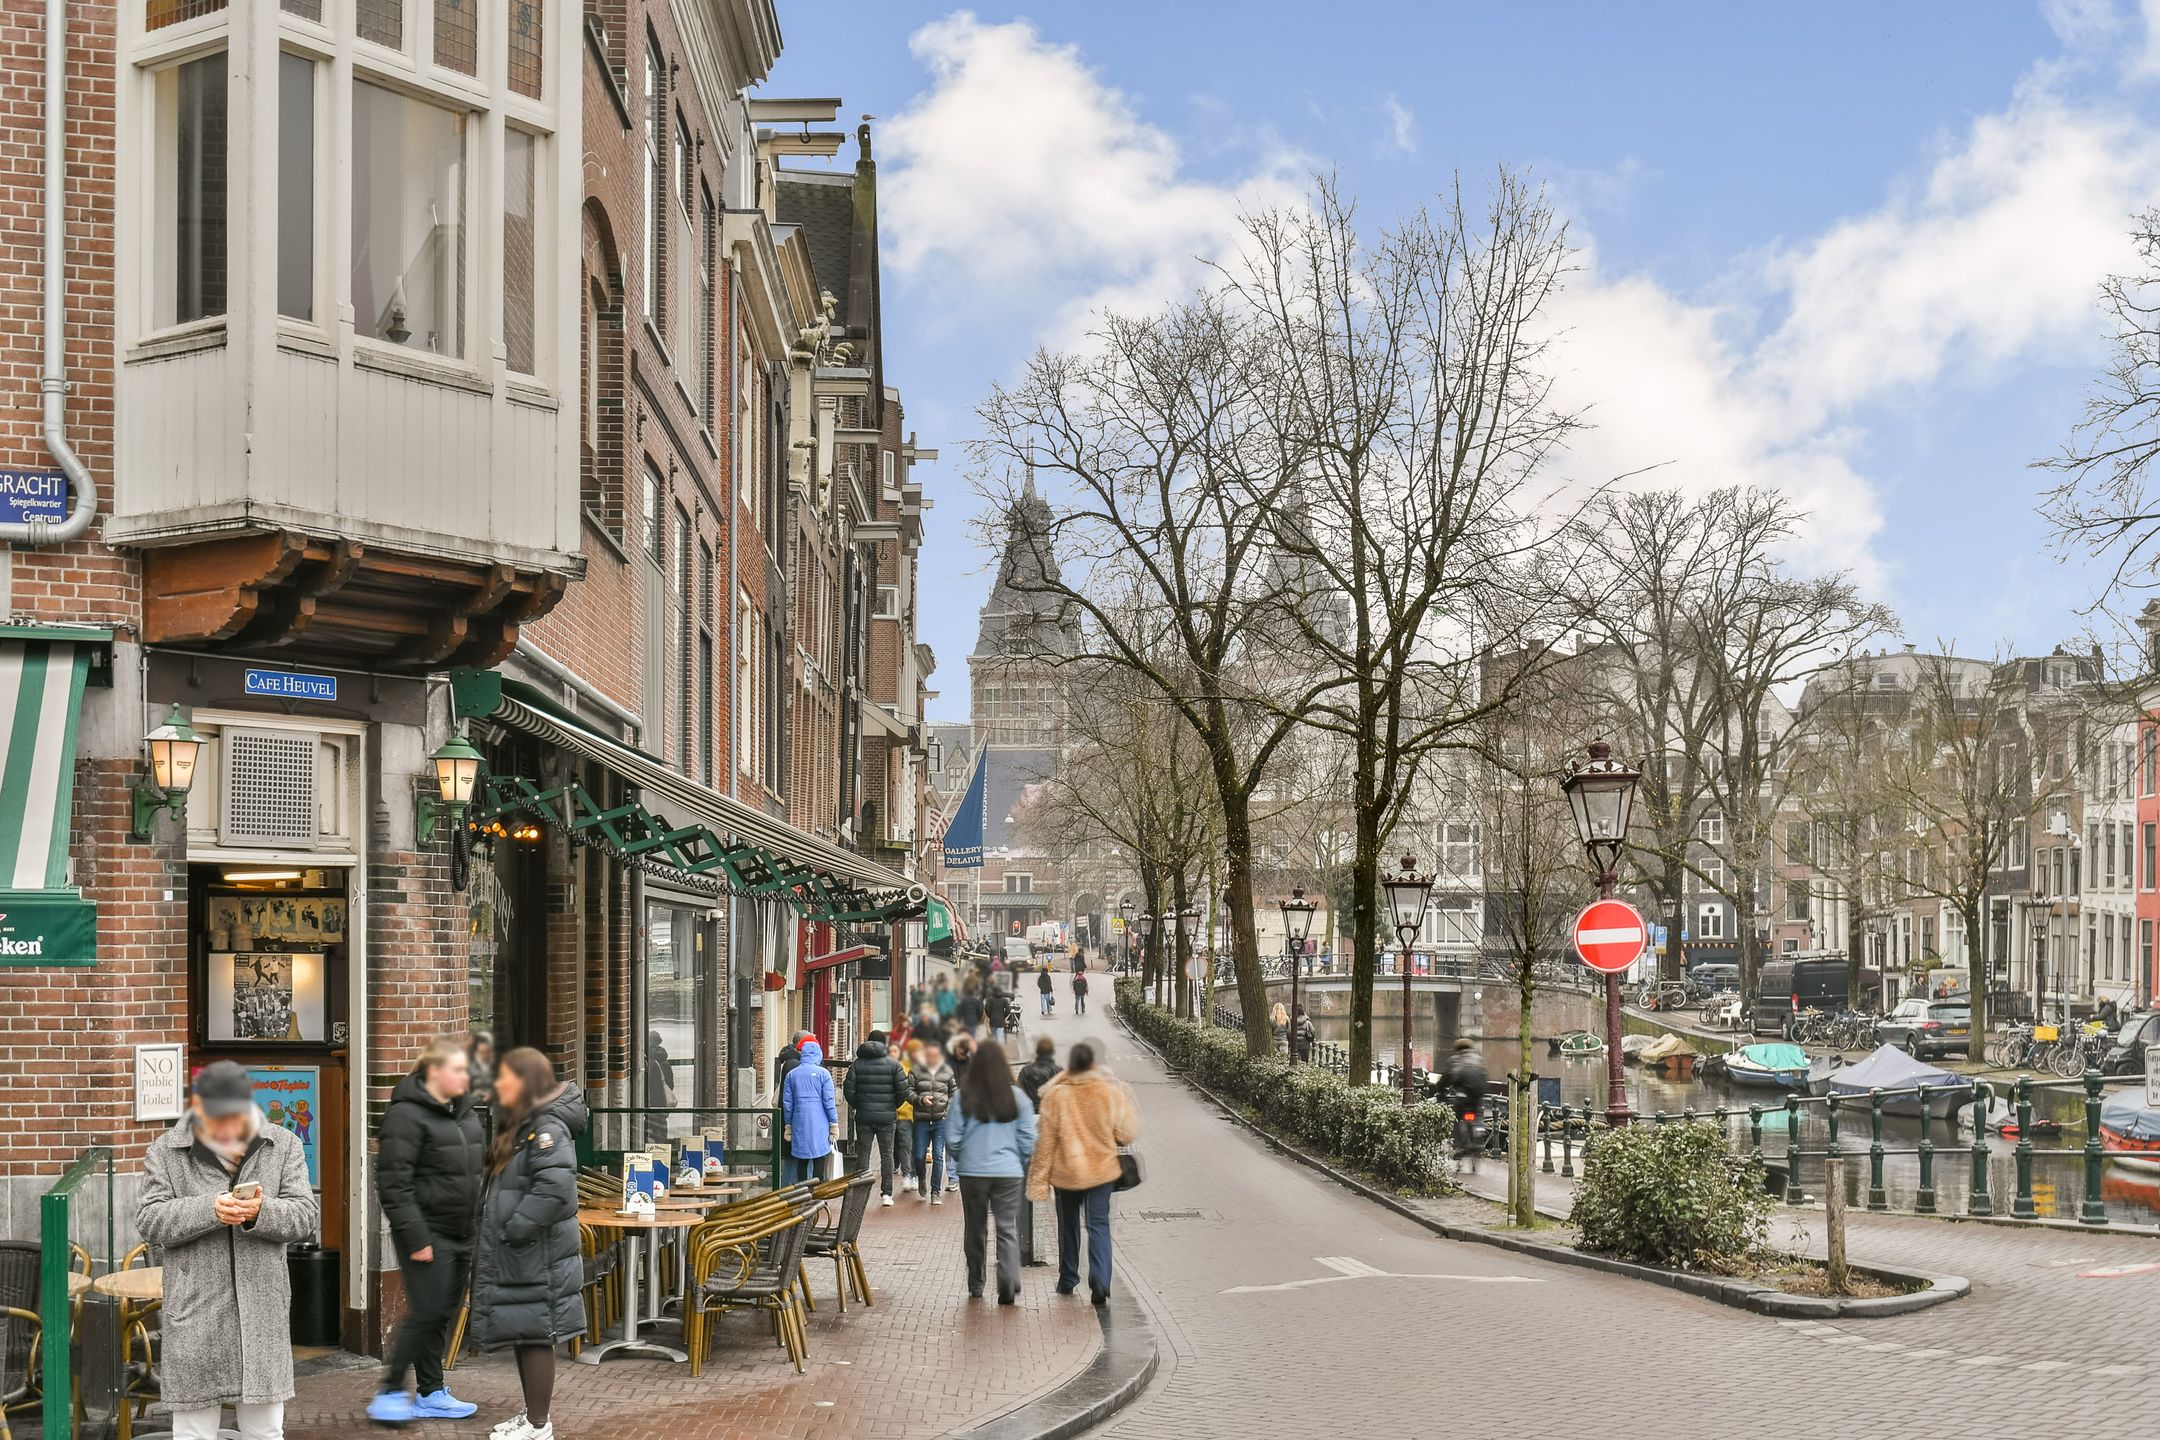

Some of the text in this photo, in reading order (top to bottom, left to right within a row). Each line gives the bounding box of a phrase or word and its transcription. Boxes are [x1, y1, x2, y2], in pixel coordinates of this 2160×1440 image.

[9, 497, 62, 509] Spiegelkwartier
[22, 511, 62, 524] Centrum
[246, 673, 334, 695] CAFE HEUVEL
[945, 846, 982, 855] GALLERY
[946, 856, 982, 864] DELAIVE
[1658, 928, 1664, 937] P
[143, 1057, 173, 1074] NO
[142, 1075, 174, 1091] public
